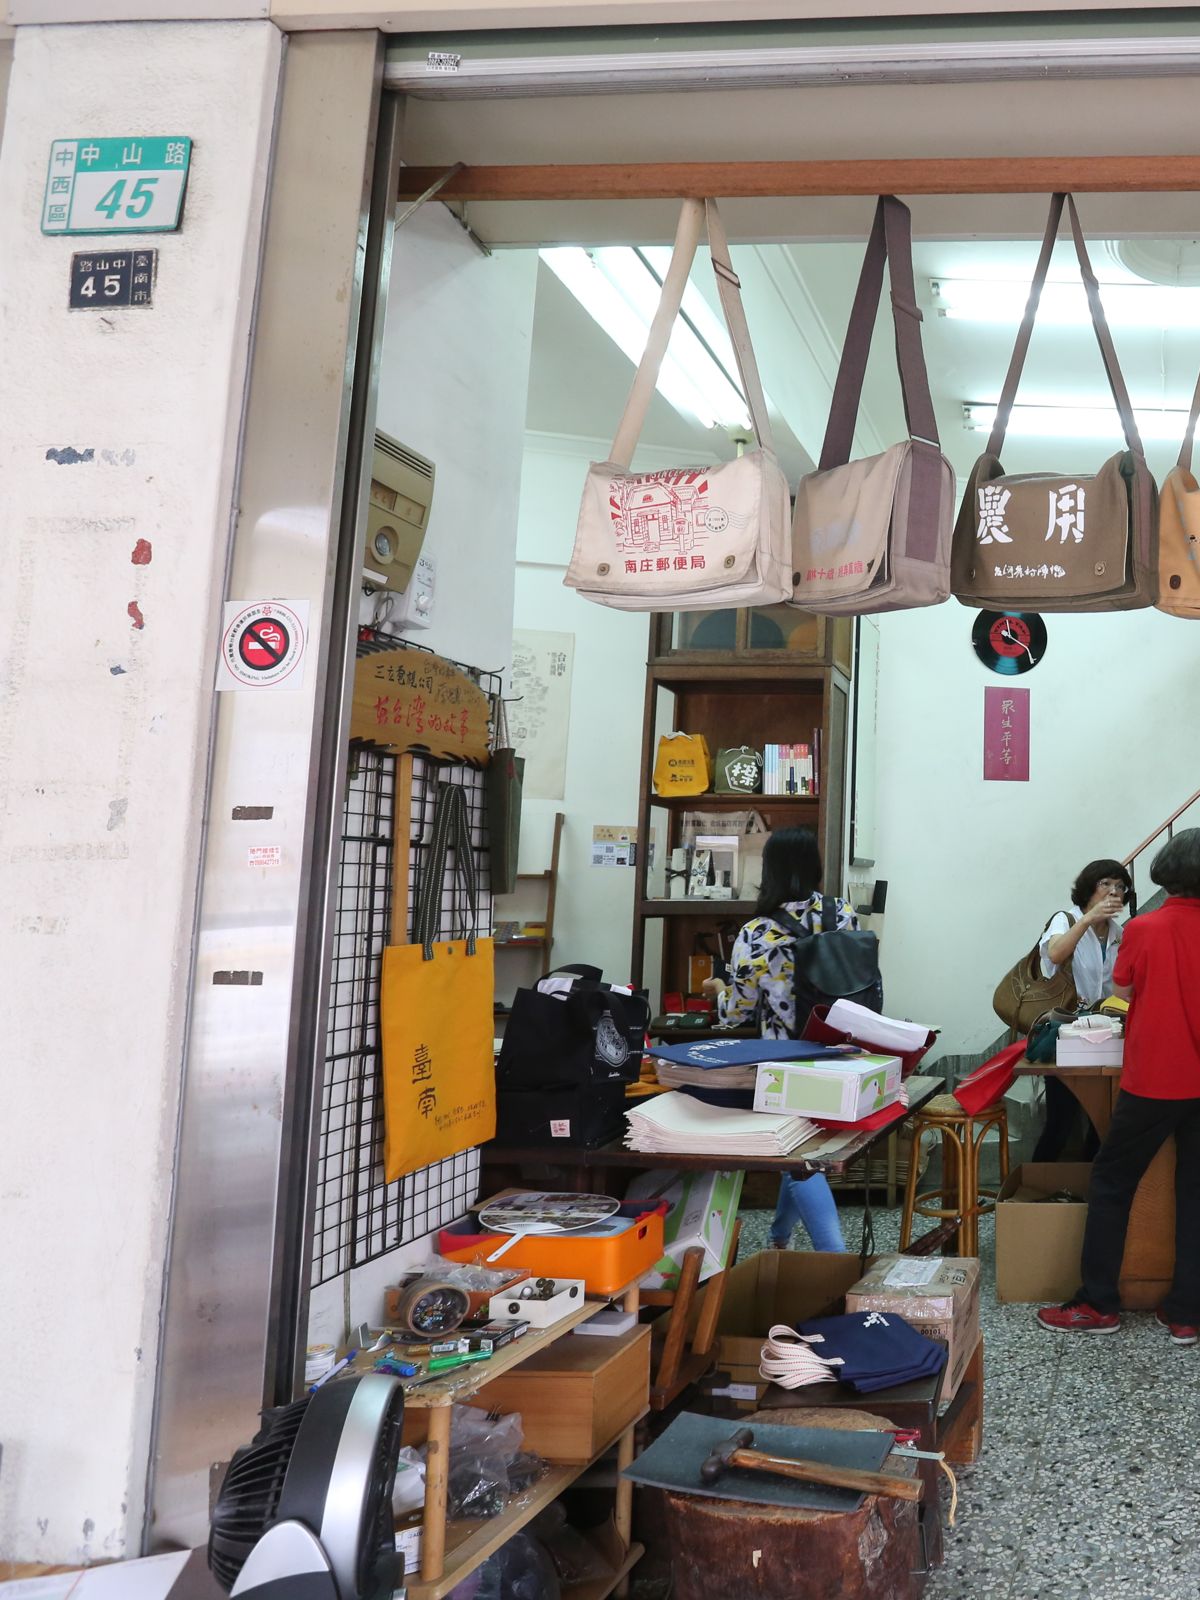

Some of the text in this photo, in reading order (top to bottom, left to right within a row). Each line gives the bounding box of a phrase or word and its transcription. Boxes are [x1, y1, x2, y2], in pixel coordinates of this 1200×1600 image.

[79, 141, 188, 168] 中山路
[47, 148, 75, 223] 中西區
[94, 177, 160, 221] 45
[80, 274, 121, 298] 45
[624, 555, 706, 574] 南庄郵便局
